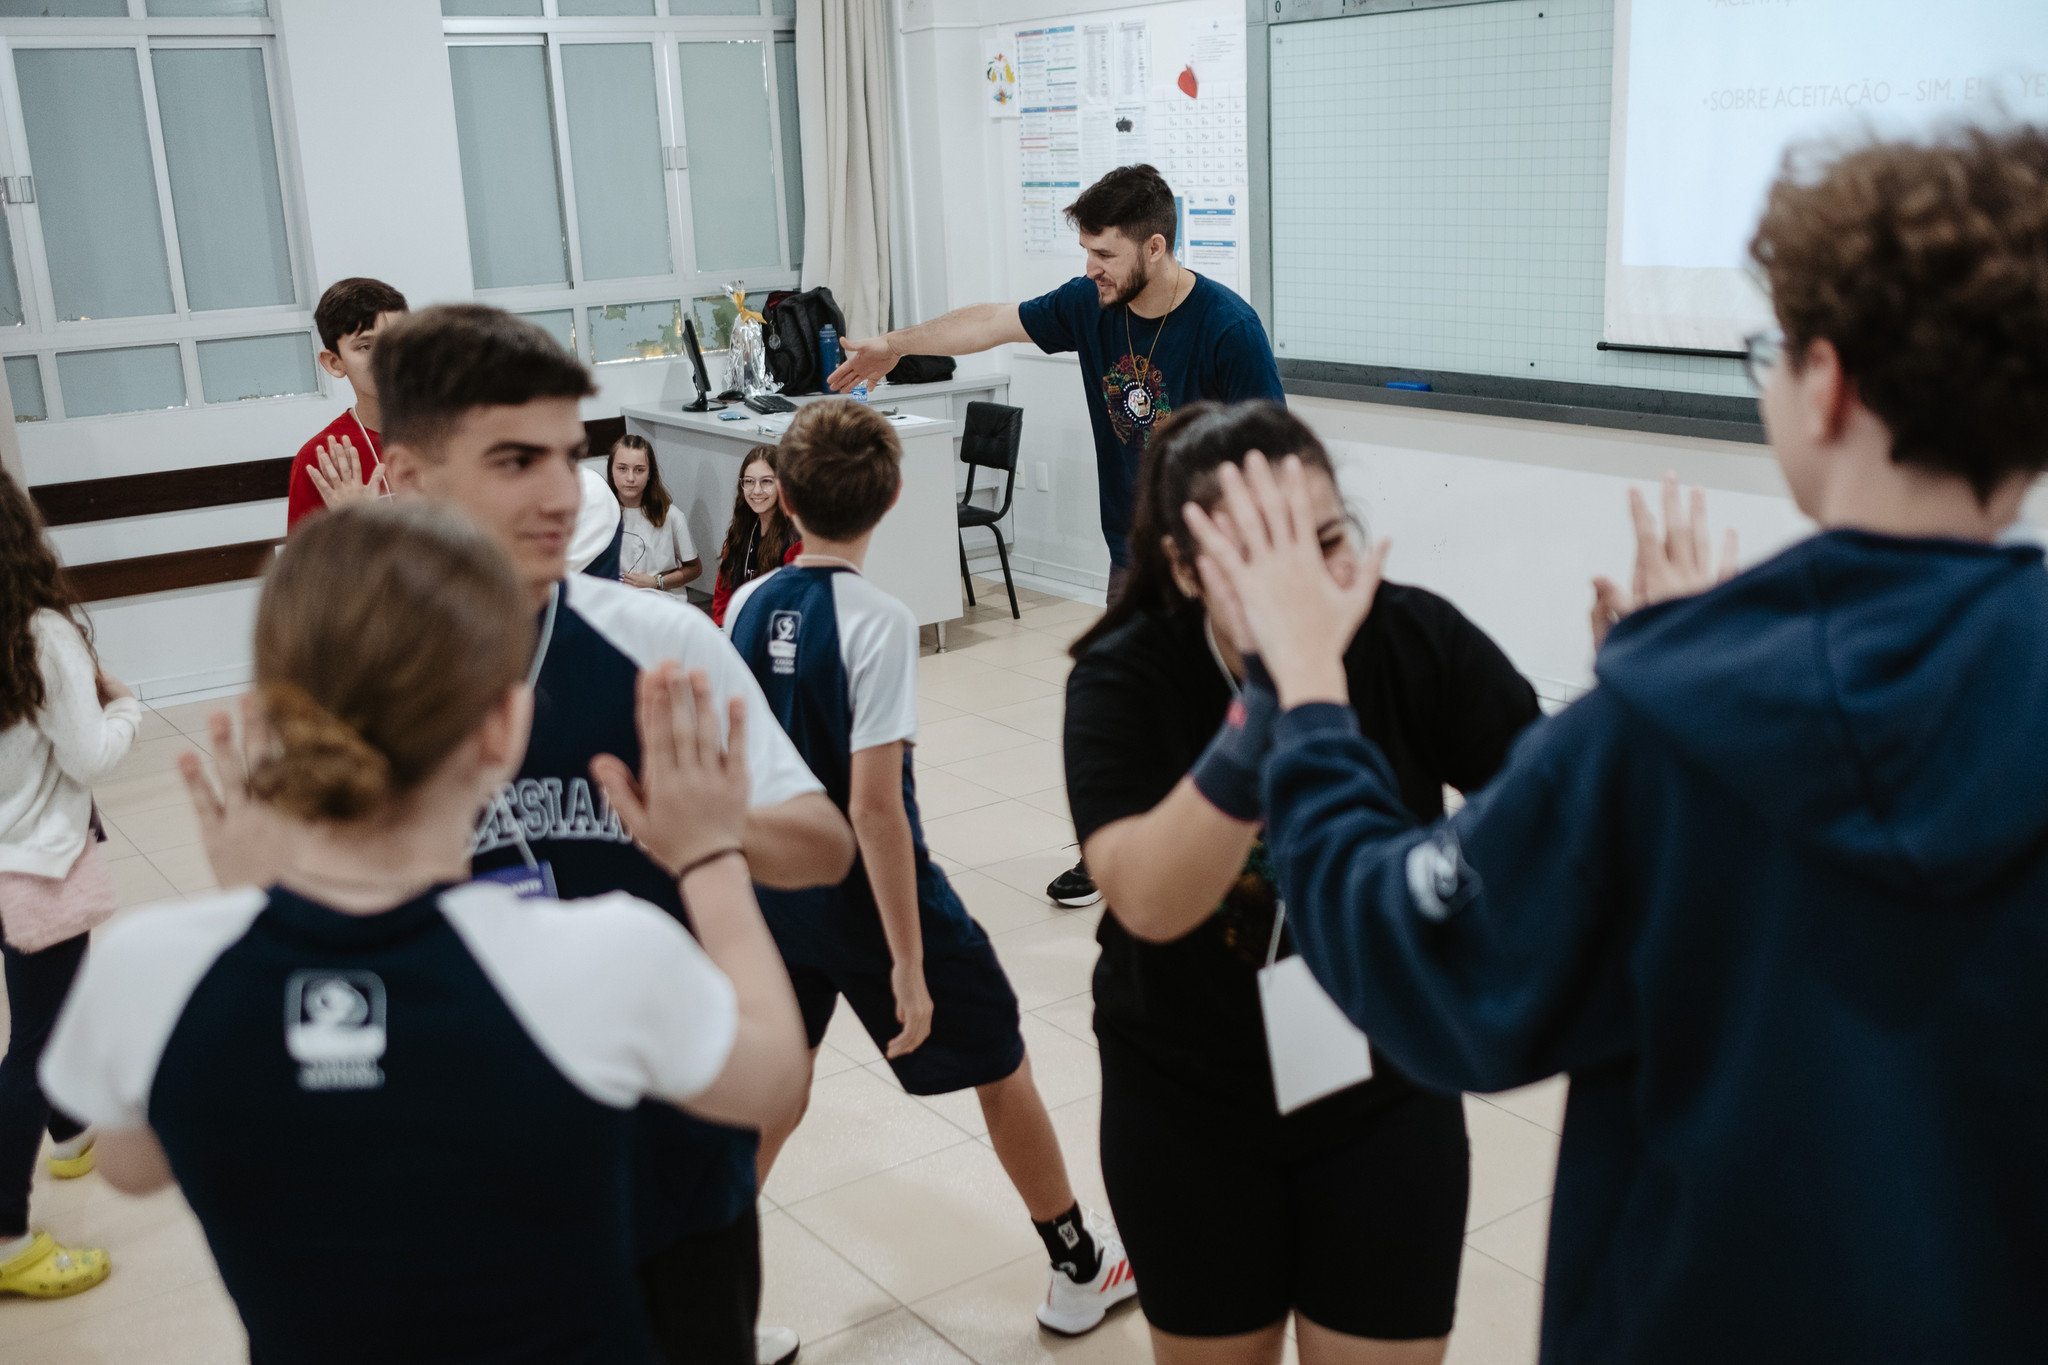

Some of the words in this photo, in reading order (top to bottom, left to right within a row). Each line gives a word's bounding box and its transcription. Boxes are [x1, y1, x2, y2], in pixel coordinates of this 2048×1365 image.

[1710, 87, 1768, 111] SOBRE
[1773, 77, 1892, 112] ACEITAÇÃO
[1915, 77, 1957, 104] SIM,
[2020, 72, 2048, 98] YE
